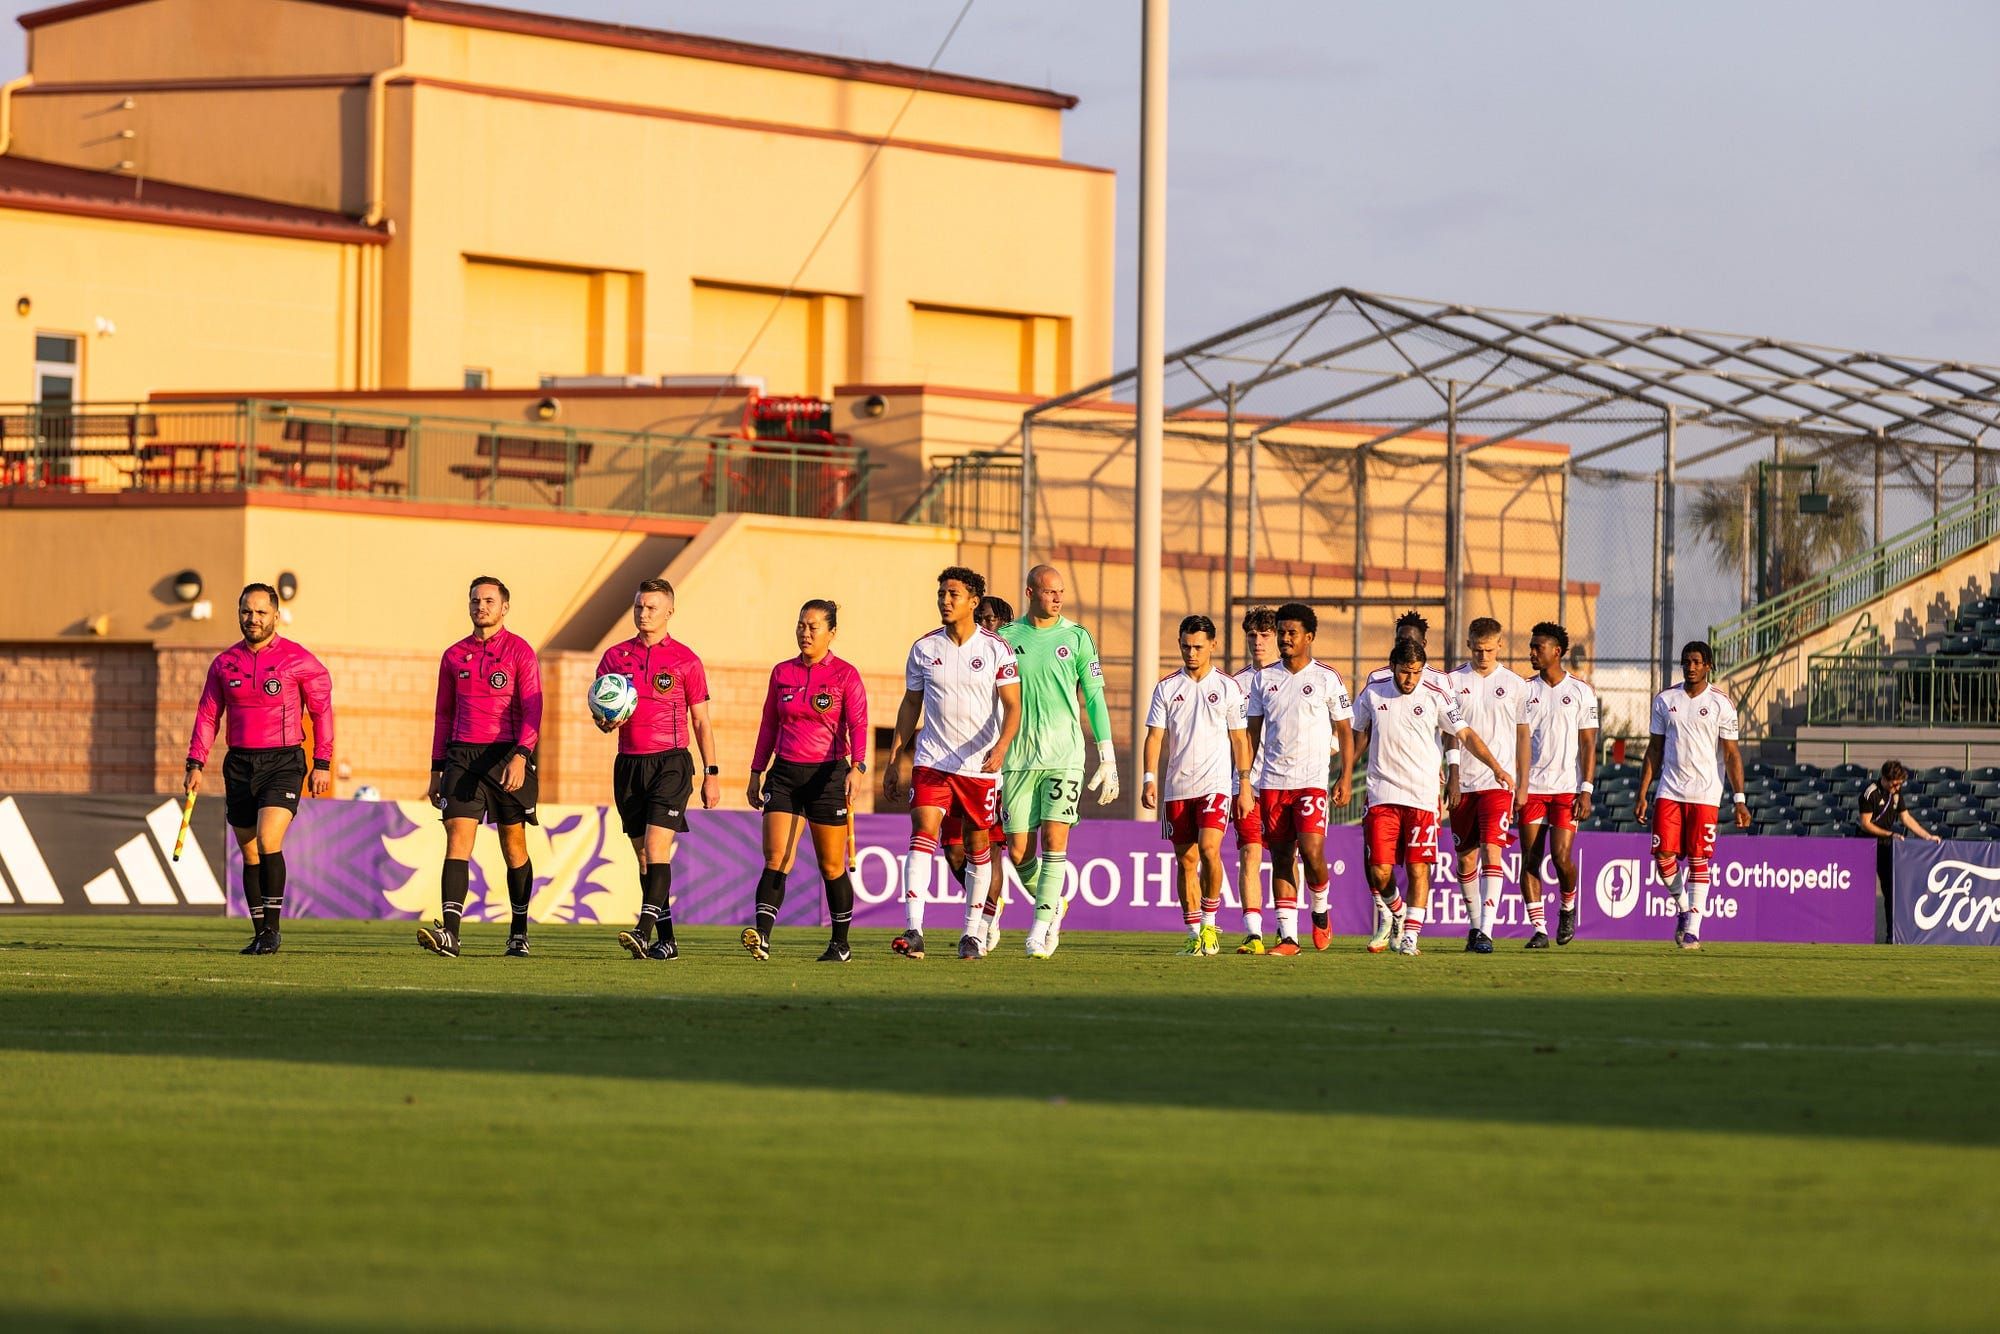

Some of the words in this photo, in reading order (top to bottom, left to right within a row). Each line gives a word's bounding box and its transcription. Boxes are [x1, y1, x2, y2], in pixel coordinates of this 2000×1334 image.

[983, 788, 995, 811] 5
[1049, 778, 1080, 802] 33
[1203, 793, 1229, 815] 14
[1300, 796, 1328, 818] 39
[1499, 812, 1509, 832] 6
[1703, 823, 1717, 843] 3
[1408, 825, 1437, 847] 11
[1725, 861, 1852, 893] Orthopedic
[1914, 859, 2000, 932] For
